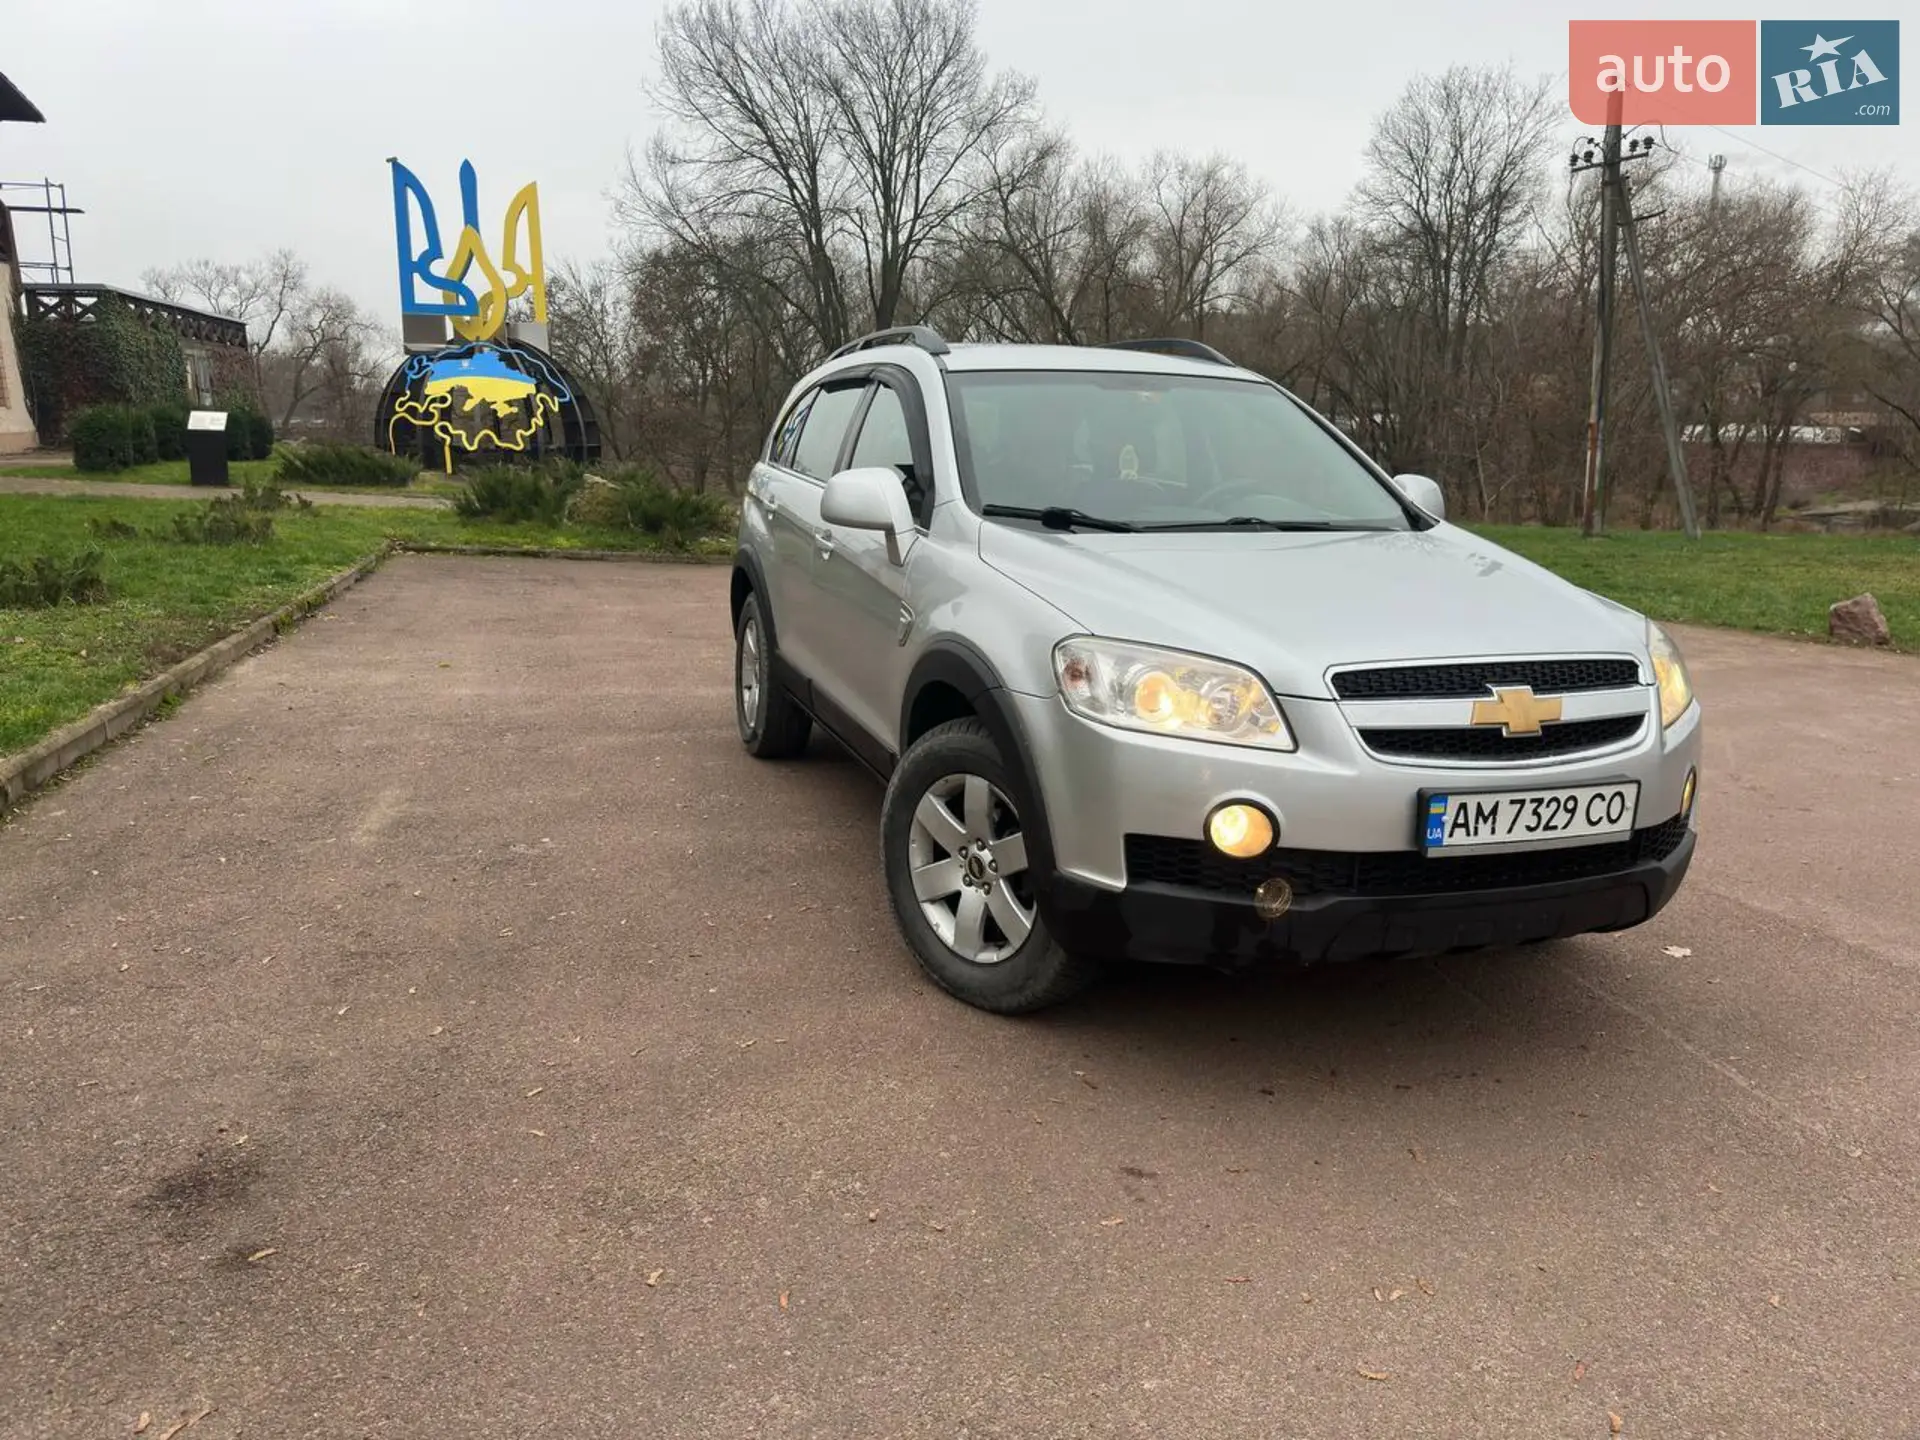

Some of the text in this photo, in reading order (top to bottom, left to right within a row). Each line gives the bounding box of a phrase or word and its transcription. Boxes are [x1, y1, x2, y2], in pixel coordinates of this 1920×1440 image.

[1448, 790, 1626, 838] AM 7329 CO
[1427, 827, 1442, 839] UA
